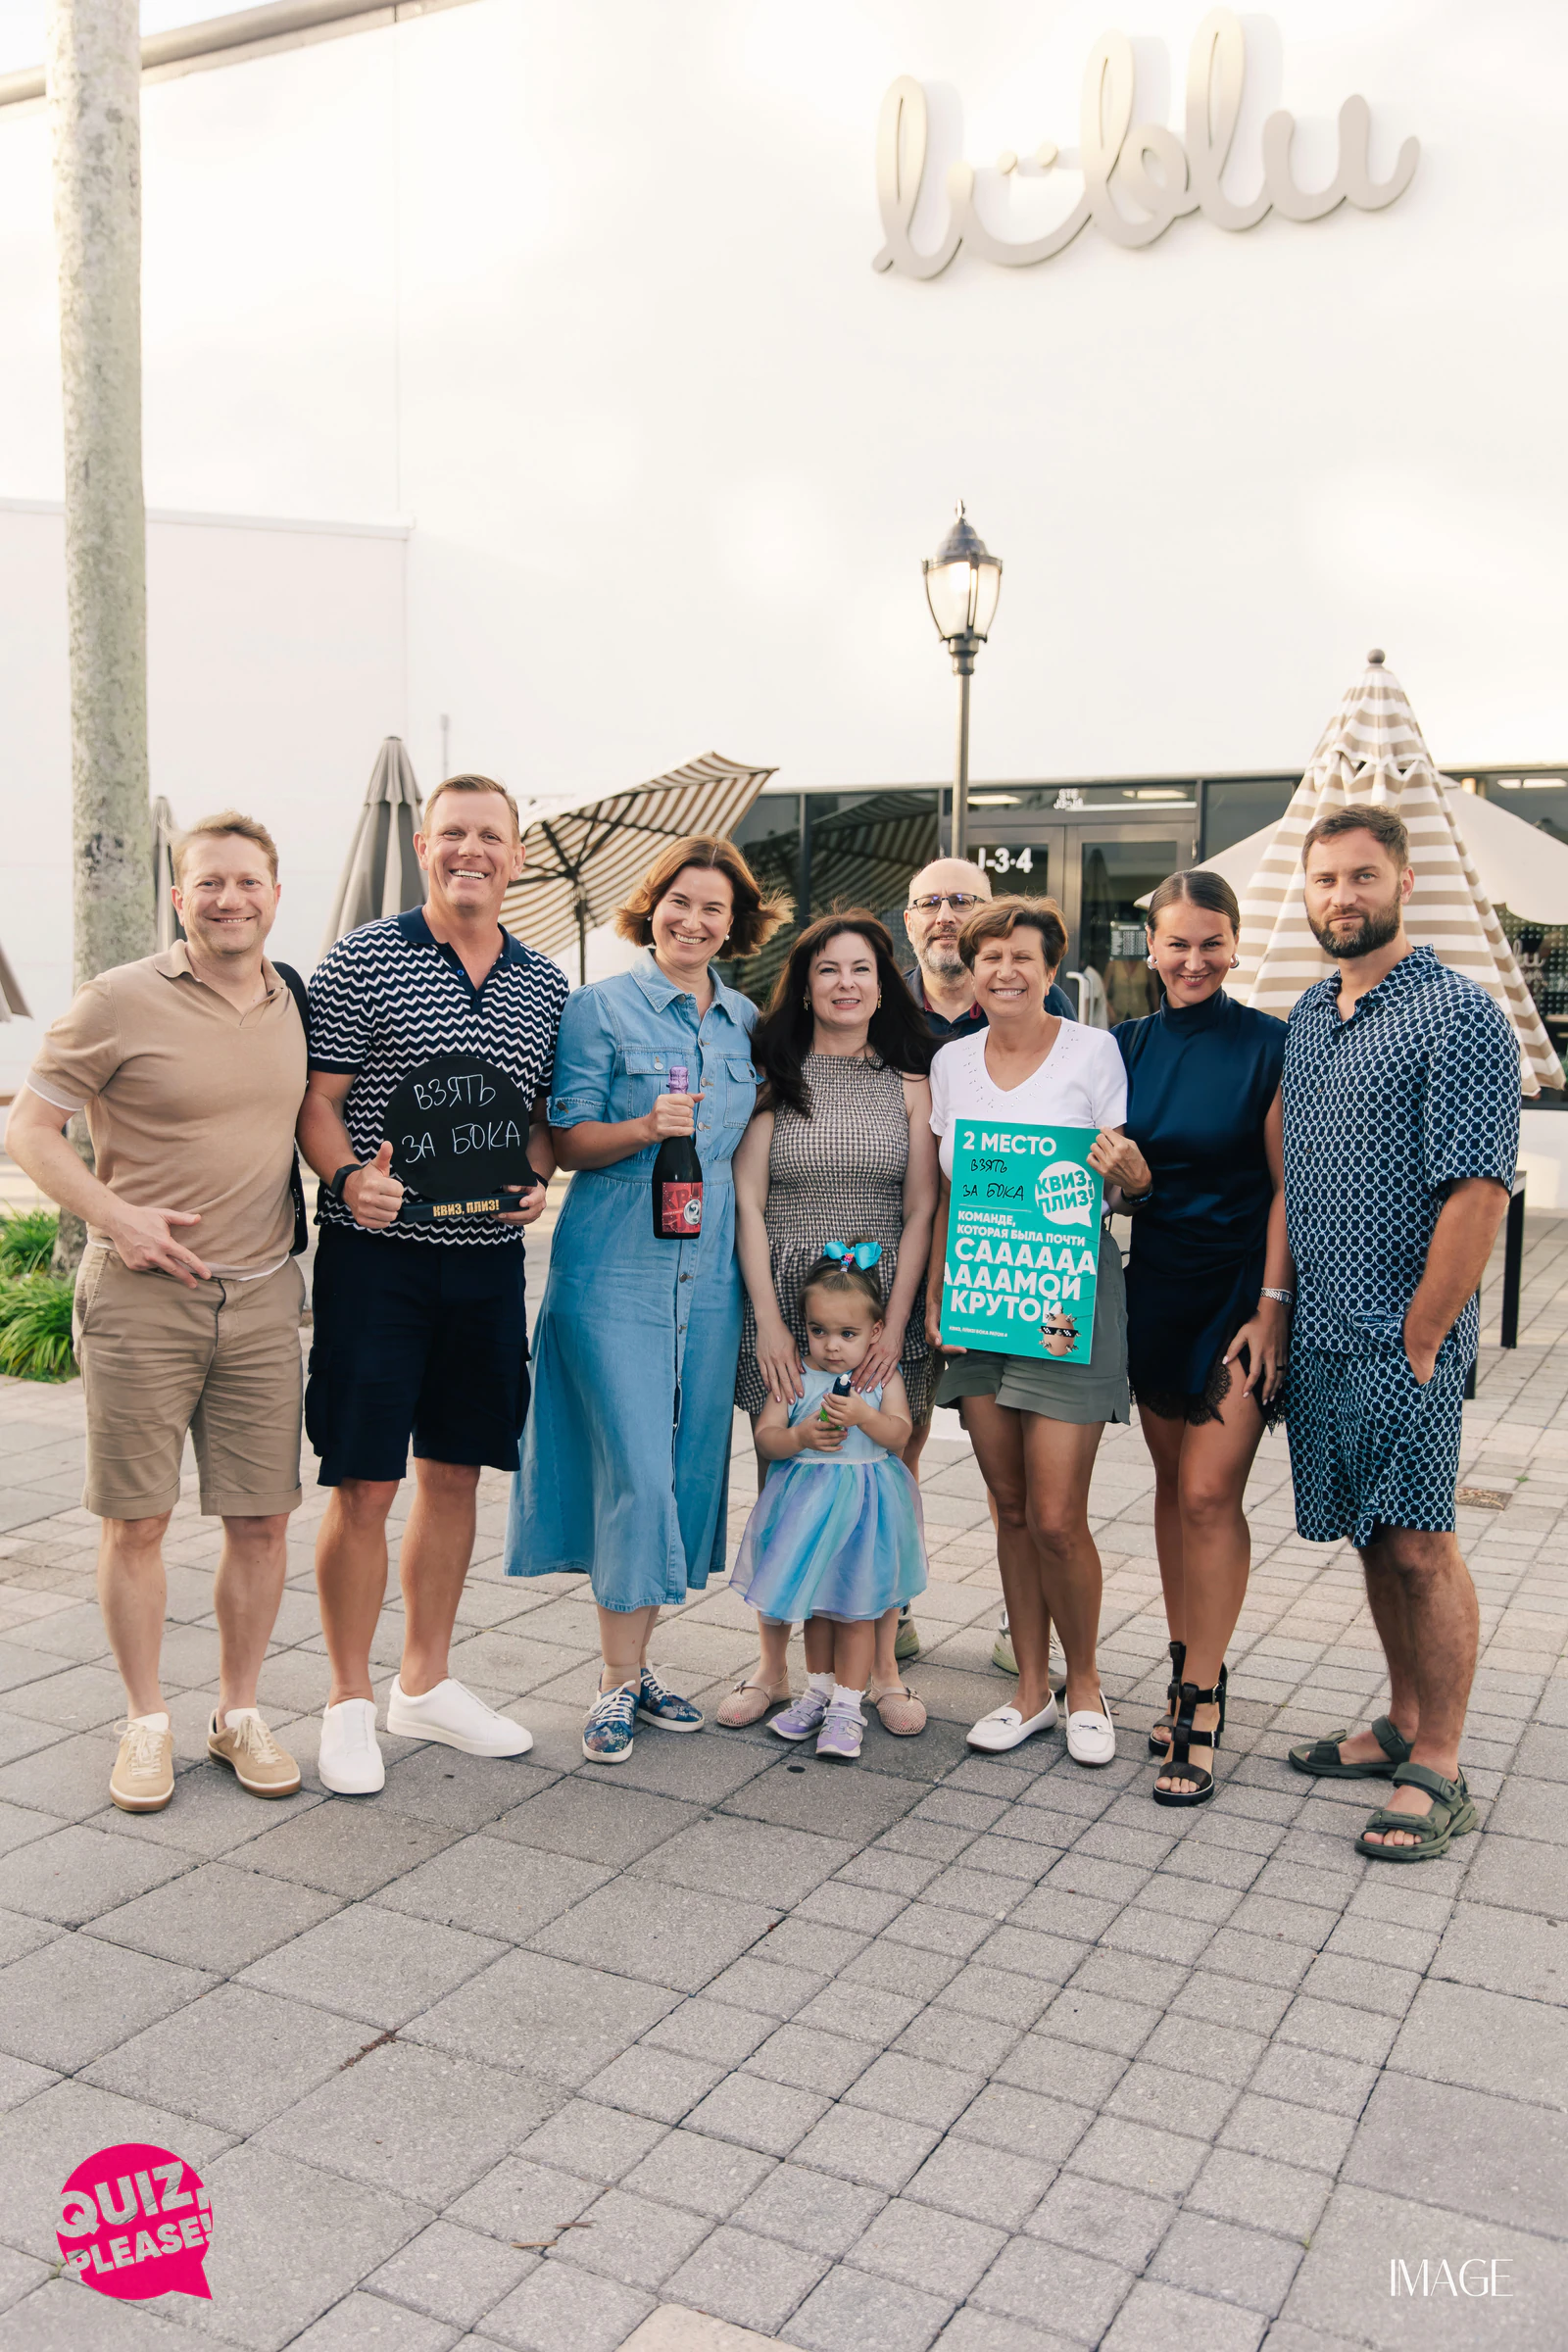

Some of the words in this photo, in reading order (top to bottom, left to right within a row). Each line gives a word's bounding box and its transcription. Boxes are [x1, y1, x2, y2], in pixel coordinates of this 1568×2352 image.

[413, 1073, 497, 1110] ВЗЯТЬ
[401, 1131, 437, 1164] ЗА
[451, 1119, 521, 1155] БОКА
[962, 1131, 976, 1151] 2
[981, 1134, 1057, 1156] МЕСТО
[970, 1157, 1008, 1174] ВЗЯТЬ
[962, 1184, 979, 1198] ЗА
[986, 1182, 1025, 1201] БОКА
[432, 1202, 466, 1218] КВИЗ,
[466, 1199, 500, 1215] ПЛИЗ!
[957, 1210, 1016, 1228] КОМАНДЕ,
[956, 1224, 1009, 1240] КОТОРАЯ
[1010, 1229, 1044, 1244] БЫЛА
[1046, 1233, 1087, 1248] ПОЧТИ
[954, 1237, 1098, 1275] САААААА
